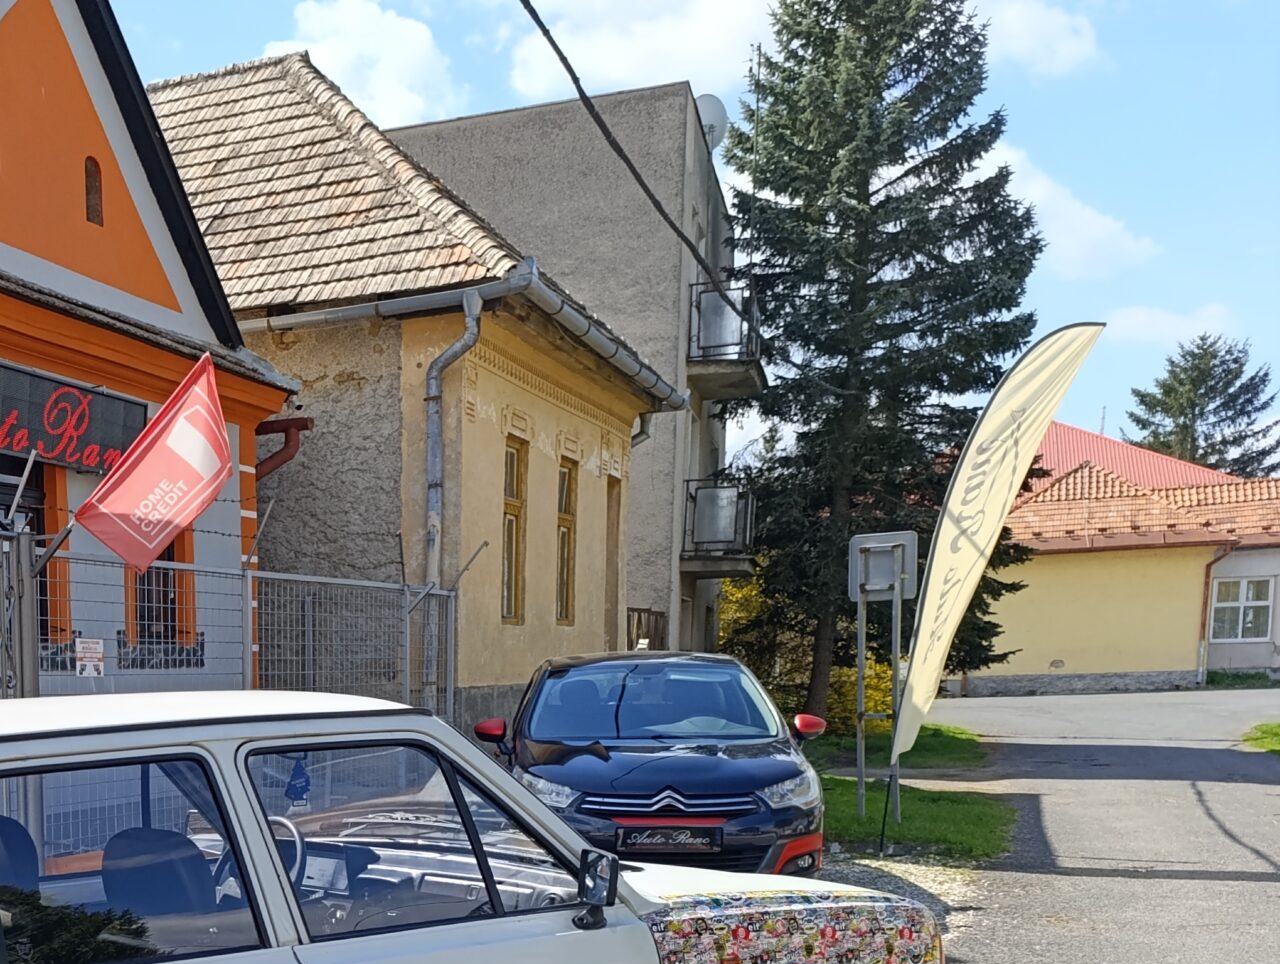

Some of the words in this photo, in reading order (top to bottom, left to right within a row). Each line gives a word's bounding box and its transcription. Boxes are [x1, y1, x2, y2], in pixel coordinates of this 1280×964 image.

[37, 385, 122, 469] Ran
[130, 478, 173, 524] HOME
[141, 480, 188, 532] CREDIT
[627, 830, 665, 844] Auto
[669, 830, 710, 844] Ranc
